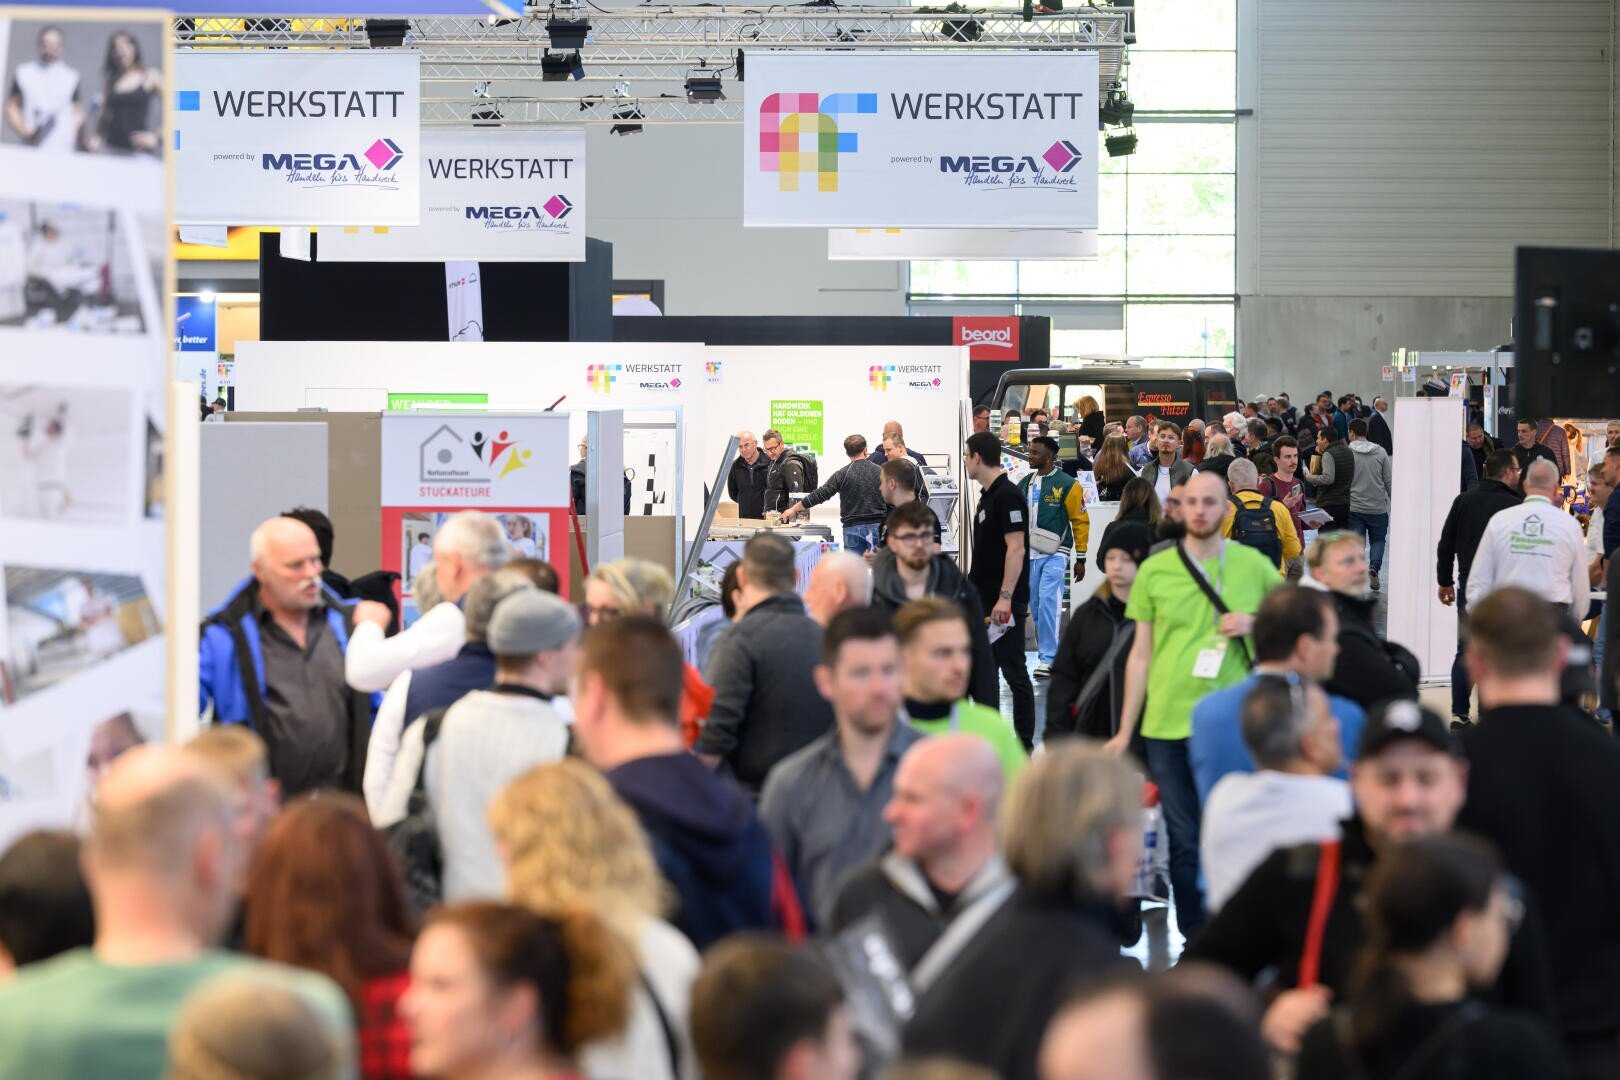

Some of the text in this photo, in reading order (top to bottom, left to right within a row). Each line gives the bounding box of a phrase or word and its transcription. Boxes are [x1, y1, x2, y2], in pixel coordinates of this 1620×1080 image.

[213, 91, 405, 117] WERKSTATT
[891, 92, 1083, 119] WERKSTATT
[213, 152, 361, 170] powered by MEGA
[890, 155, 1039, 172] powered by MEGA
[428, 158, 574, 179] WERKSTATT
[963, 169, 1004, 186] Handeln
[1032, 168, 1077, 186] Handwerk
[465, 206, 540, 219] MEGA
[182, 335, 208, 344] better
[961, 326, 1011, 341] beorol
[625, 364, 682, 373] WERKSTATT
[898, 365, 942, 373] WERKSTATT
[1138, 391, 1171, 403] Espresso
[773, 402, 811, 410] HANDWERK
[419, 486, 492, 498] STUCKATEURE
